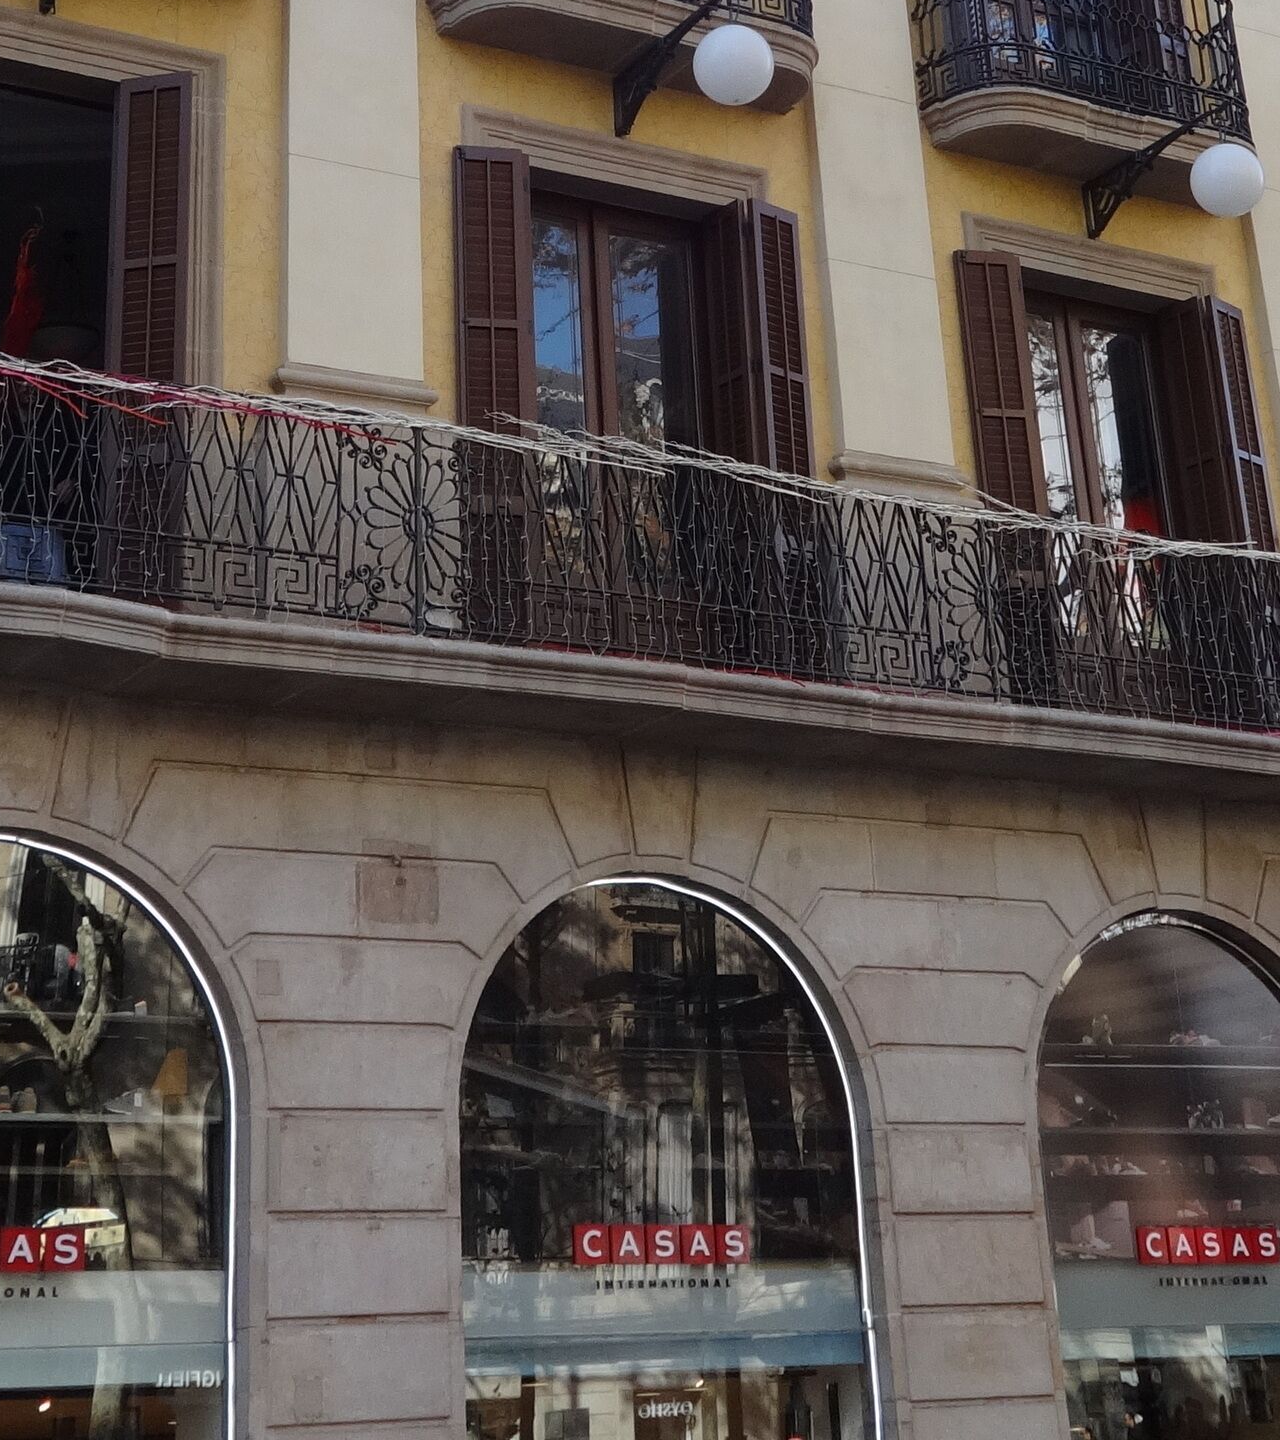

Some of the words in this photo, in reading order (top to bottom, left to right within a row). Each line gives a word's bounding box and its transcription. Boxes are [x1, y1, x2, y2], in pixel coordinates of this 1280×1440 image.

[583, 1230, 745, 1257] CASAS
[1146, 1232, 1276, 1257] CASAS
[596, 1278, 731, 1290] INTERNATIONAL
[1159, 1276, 1268, 1287] INTERNATONAL
